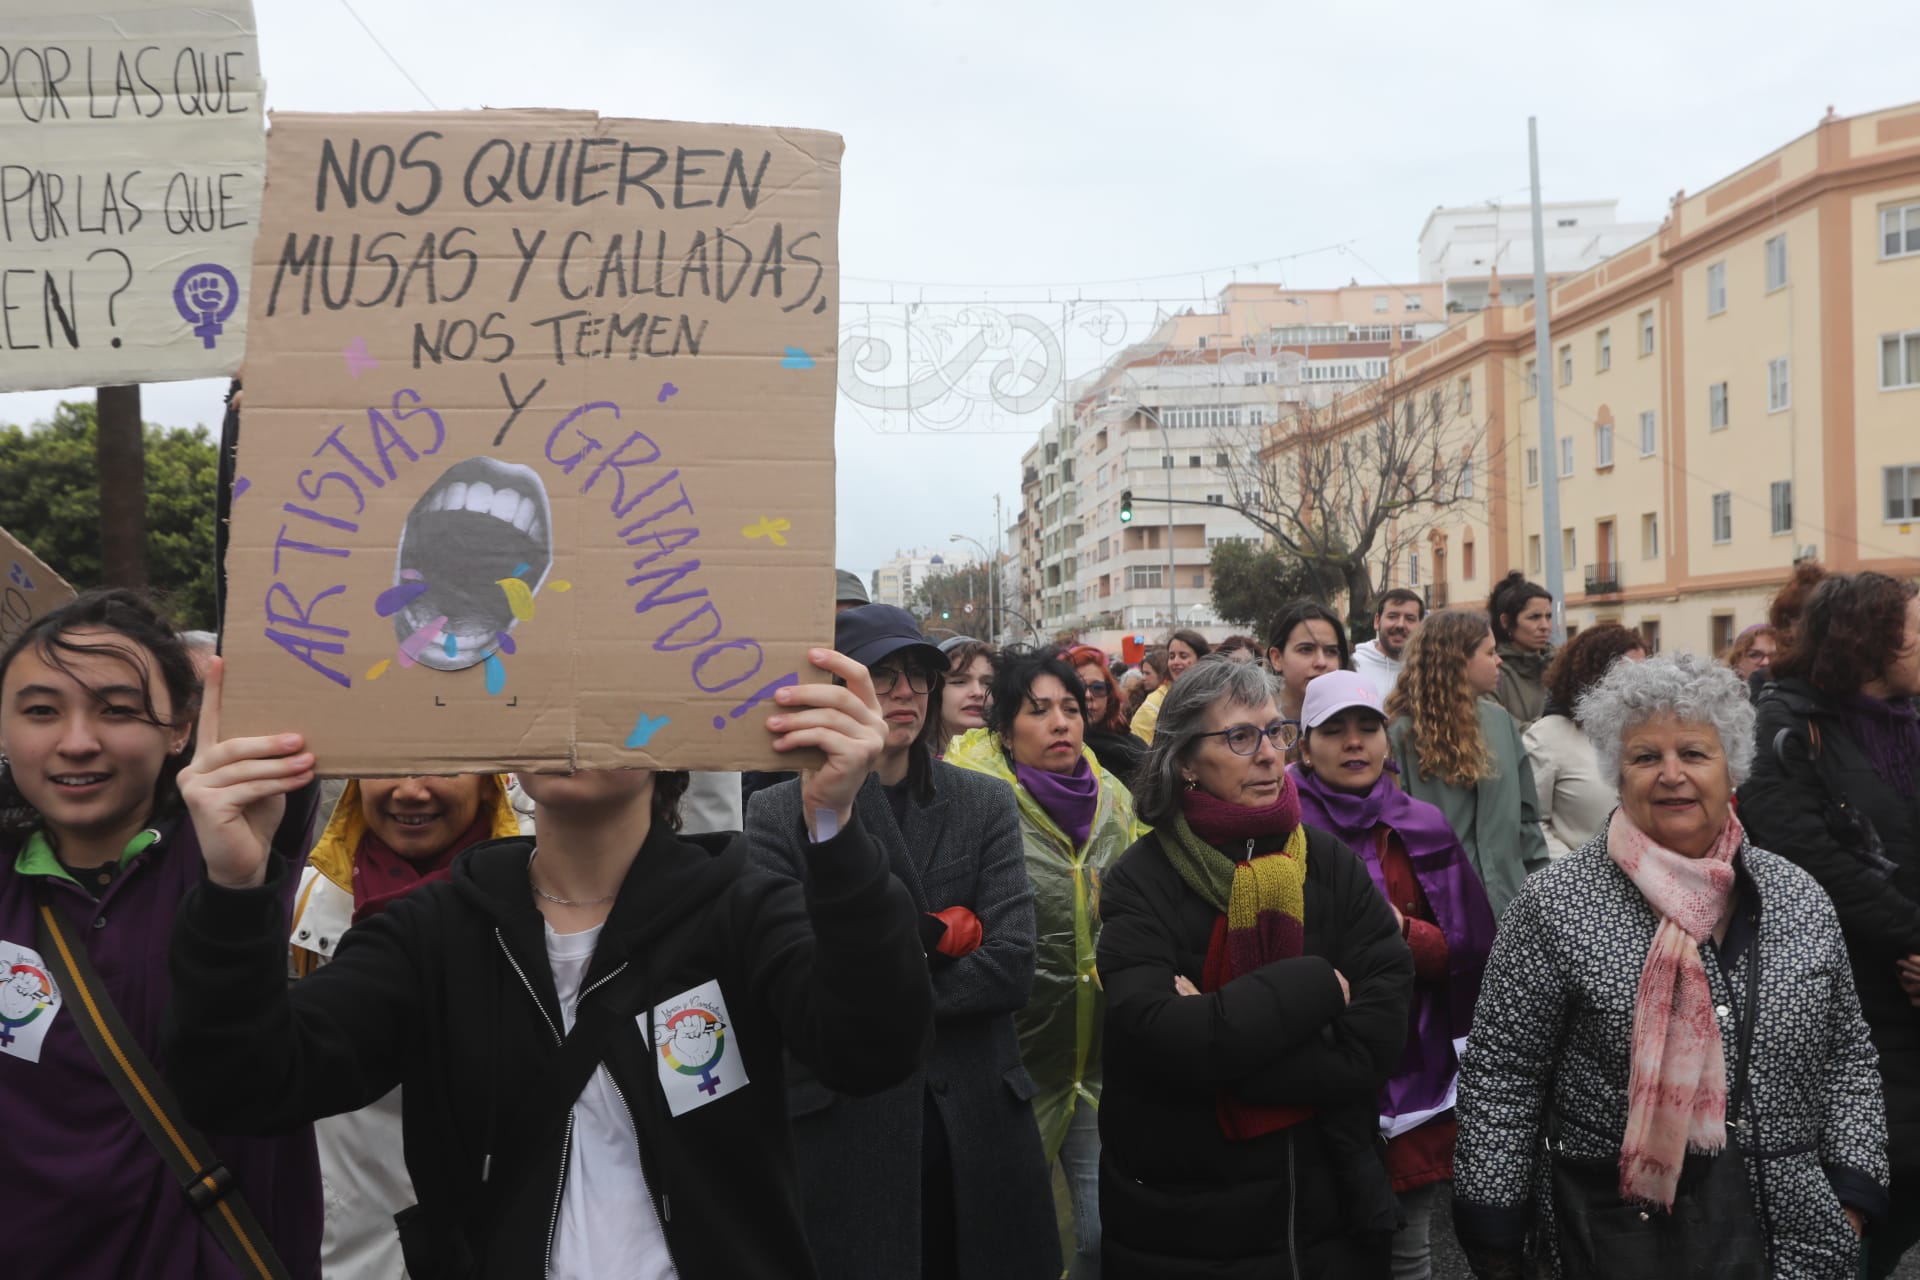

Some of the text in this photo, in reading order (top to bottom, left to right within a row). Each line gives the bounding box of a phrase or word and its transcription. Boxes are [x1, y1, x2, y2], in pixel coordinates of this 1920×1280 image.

[87, 46, 163, 119] LAS
[174, 47, 248, 117] QUE
[1, 165, 247, 242] POR LAS QUE
[315, 130, 771, 215] NOS QUIEREN
[0, 248, 133, 350] EN?
[266, 222, 827, 316] MUSAS Y CALLADAS,
[412, 310, 708, 369] NOS TEMEN
[265, 372, 798, 729] ARTISTAS Y GRITANDO!
